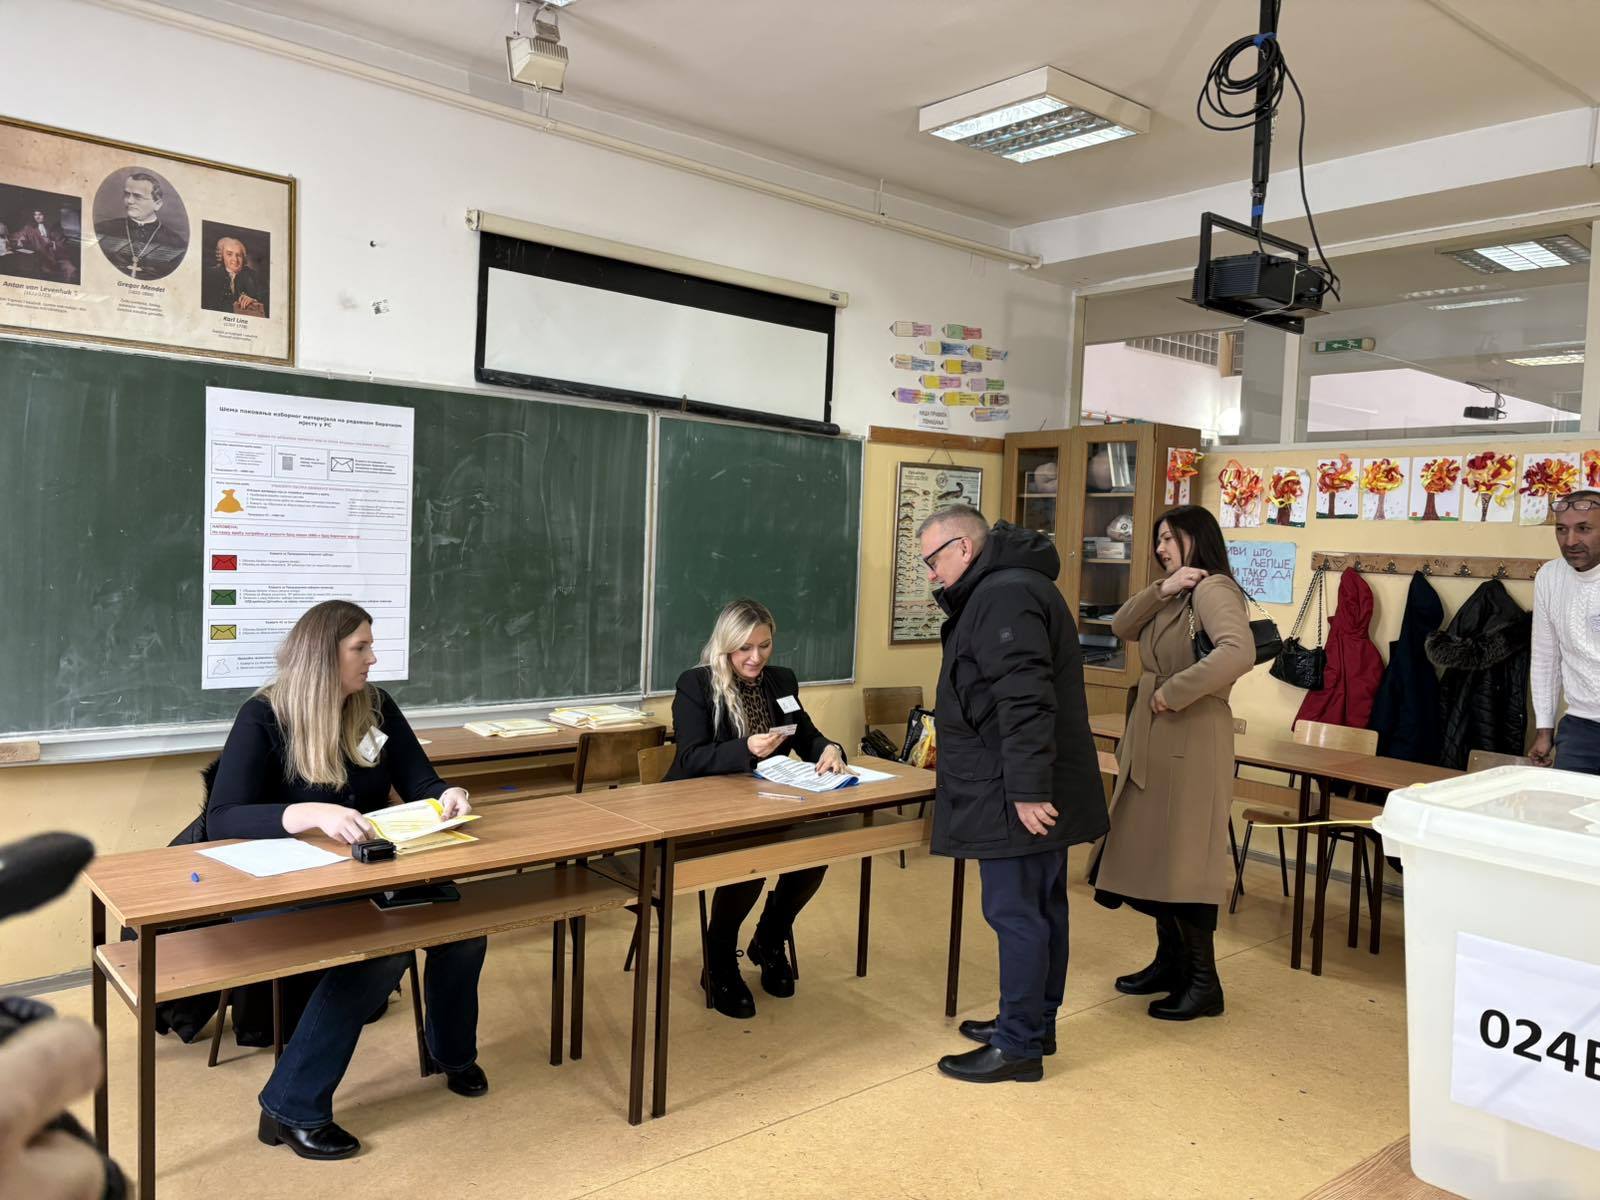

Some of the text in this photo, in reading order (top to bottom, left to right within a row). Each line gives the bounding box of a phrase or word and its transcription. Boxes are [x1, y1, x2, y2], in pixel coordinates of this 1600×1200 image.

[116, 280, 166, 293] Gregor Mendel
[219, 405, 239, 413] Шема
[1227, 546, 1273, 558] ИВИ ШТО
[1242, 567, 1268, 578] ТАКО
[1271, 570, 1291, 580] ДА
